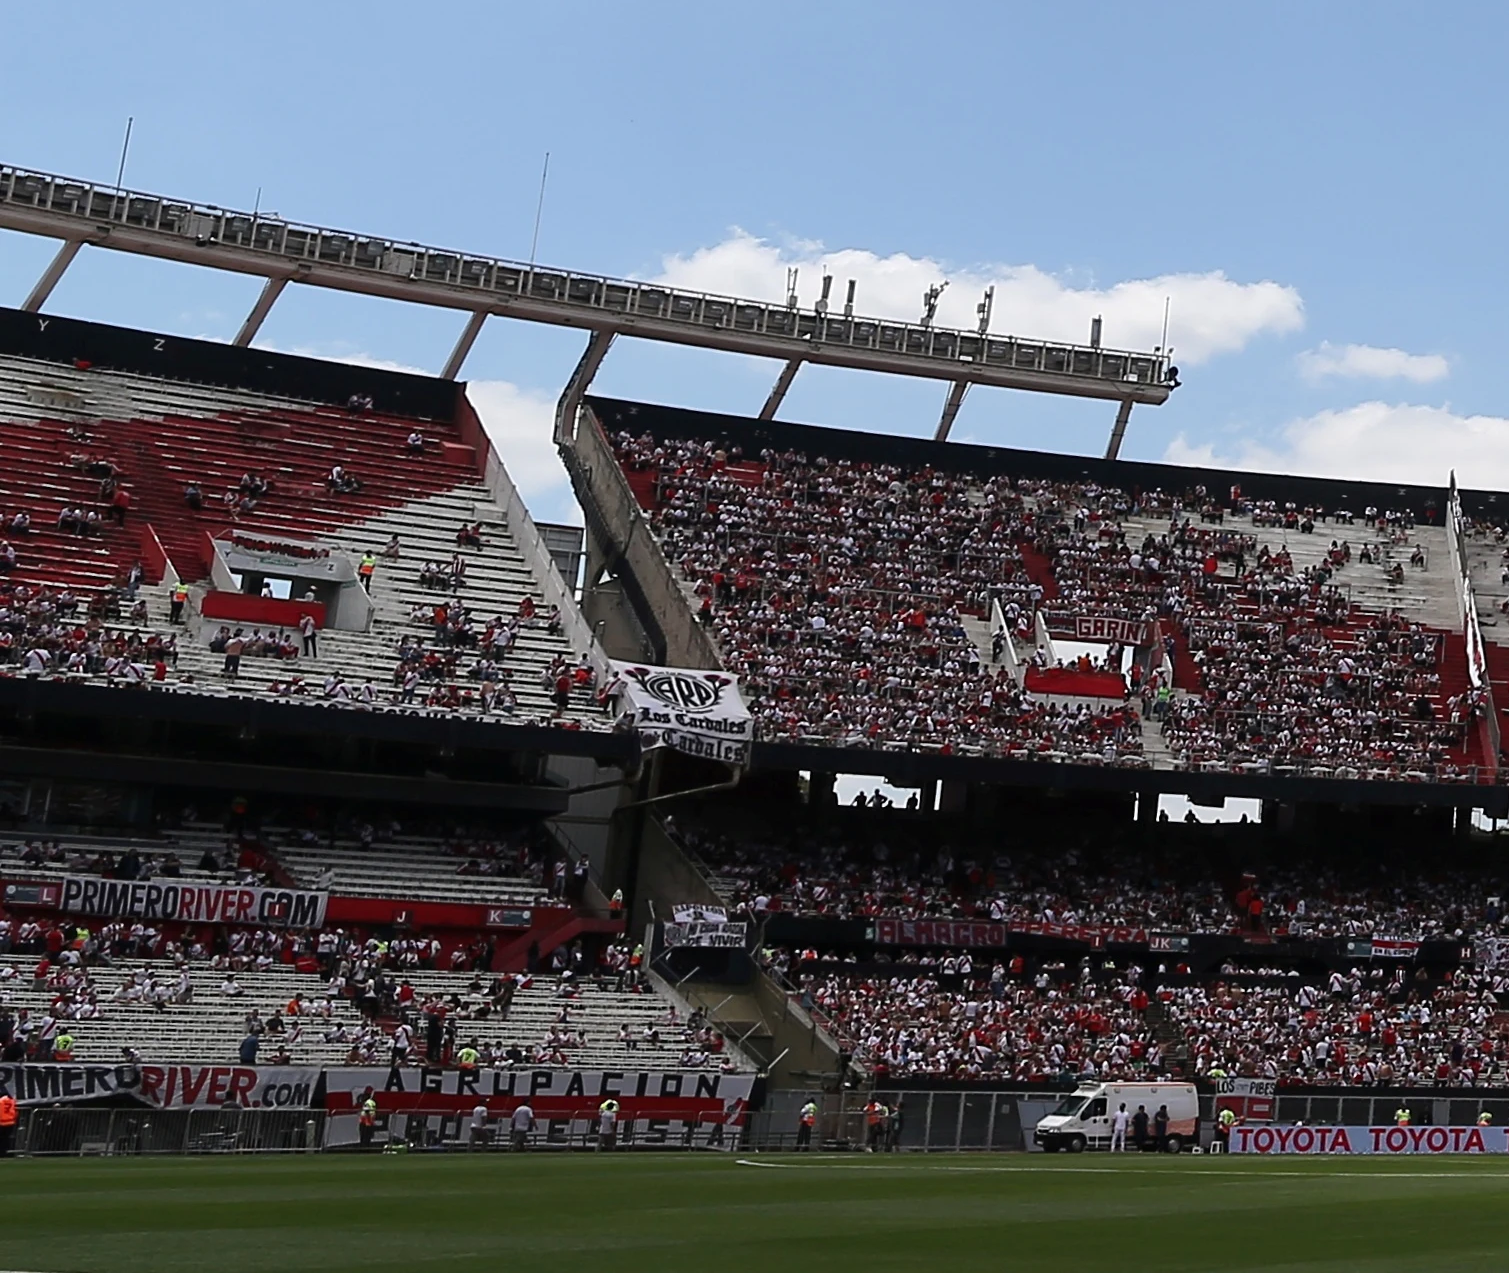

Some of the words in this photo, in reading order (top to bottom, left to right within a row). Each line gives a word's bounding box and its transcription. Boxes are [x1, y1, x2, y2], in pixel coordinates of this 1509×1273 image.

[38, 319, 49, 332] Y
[153, 338, 166, 351] Z
[1079, 618, 1140, 642] GARIN
[638, 707, 671, 724] Los
[675, 712, 748, 735] Cardales
[662, 729, 745, 762] Cardales
[42, 887, 52, 902] L
[396, 912, 405, 924] J
[488, 910, 500, 923] K
[880, 923, 1006, 945] ALMAGRO
[1151, 937, 1171, 949] JK
[1461, 947, 1471, 958] H
[385, 1067, 721, 1098] AGRUPACION
[1217, 1080, 1235, 1094] LOS
[1249, 1081, 1276, 1095] PIBES
[1237, 1128, 1351, 1152] TOYOTA
[1369, 1128, 1486, 1152] TOYOTA
